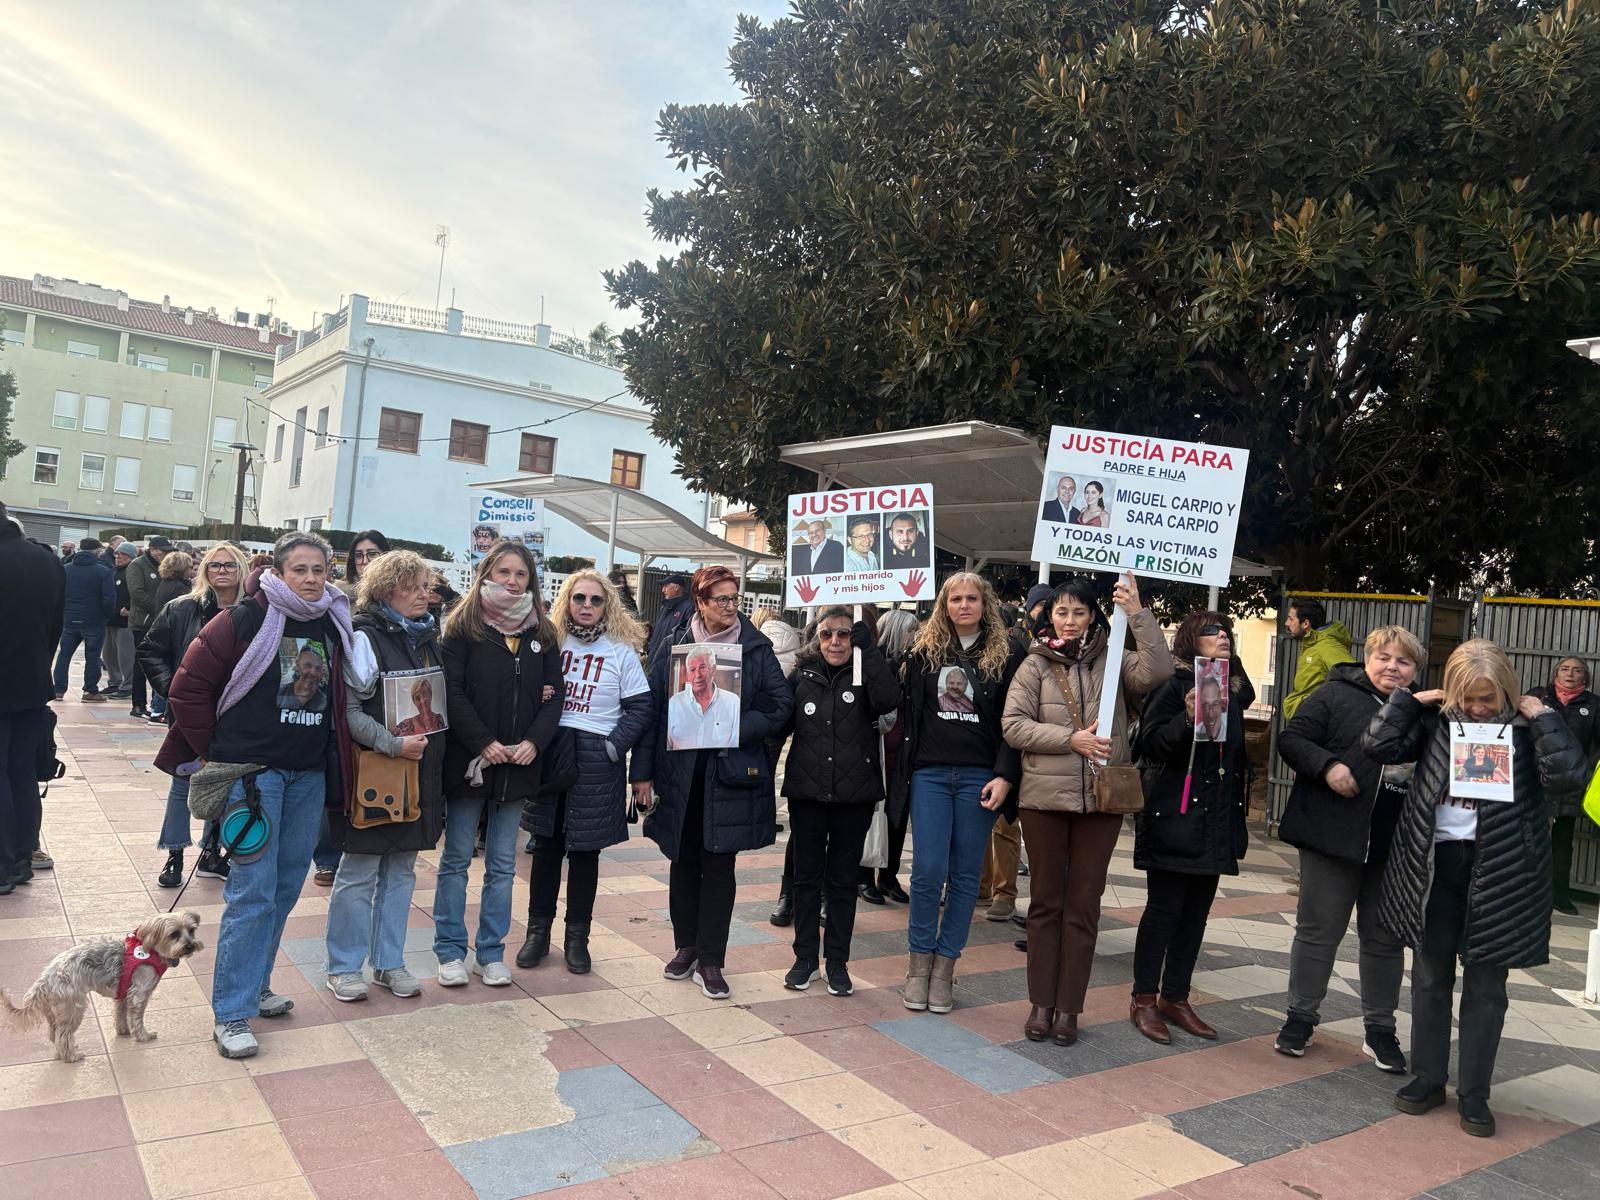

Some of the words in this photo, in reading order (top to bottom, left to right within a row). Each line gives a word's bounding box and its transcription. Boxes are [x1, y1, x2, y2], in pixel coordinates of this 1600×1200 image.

[1171, 446, 1234, 471] PARA
[1103, 461, 1144, 475] PADRE
[1147, 466, 1156, 476] E
[1159, 468, 1187, 481] HIJA
[482, 496, 534, 511] Consell
[792, 487, 929, 517] JUSTICIA
[1116, 489, 1167, 508] MIGUEL
[1171, 496, 1223, 515] CARPIO
[1226, 503, 1236, 517] Y
[479, 509, 536, 522] Dimissió
[1126, 509, 1163, 527] SARA
[1167, 515, 1219, 534] CARPIO
[1050, 526, 1061, 538] Y
[1064, 528, 1113, 545] TODAS
[1117, 535, 1145, 549] LAS
[1150, 539, 1218, 559] VICTIMAS
[1058, 543, 1121, 565] MAZÓN
[1135, 554, 1204, 576] PRISIÓN
[825, 574, 842, 583] por
[844, 573, 857, 581] mi
[859, 571, 893, 580] marido
[833, 586, 839, 594] y
[842, 584, 859, 593] mis
[861, 583, 885, 592] hijos
[560, 649, 605, 683] 0:11
[565, 680, 598, 701] BLIT
[280, 708, 323, 727] Felipe
